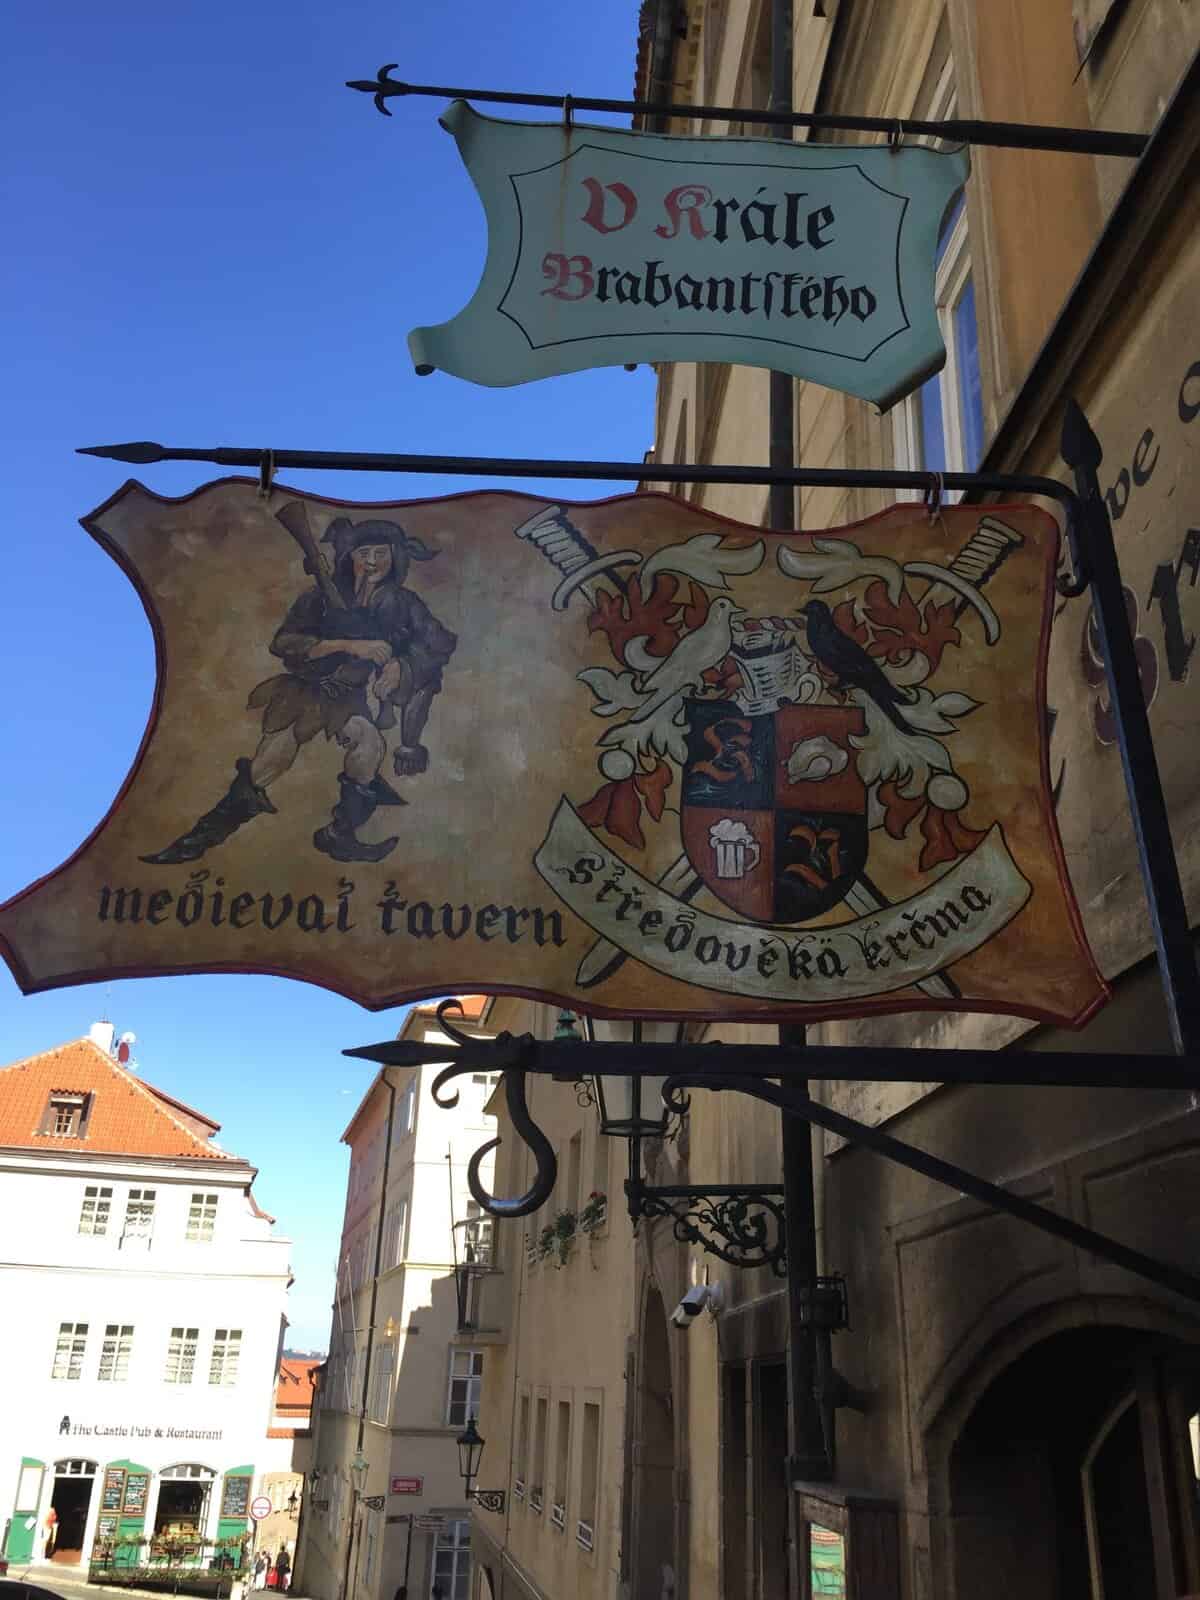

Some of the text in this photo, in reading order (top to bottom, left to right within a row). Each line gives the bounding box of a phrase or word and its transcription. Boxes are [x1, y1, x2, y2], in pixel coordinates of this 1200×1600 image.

[653, 186, 836, 251] Krále
[97, 869, 354, 933] medieval
[94, 1424, 128, 1437] Castle
[166, 1427, 223, 1441] Restaurant
